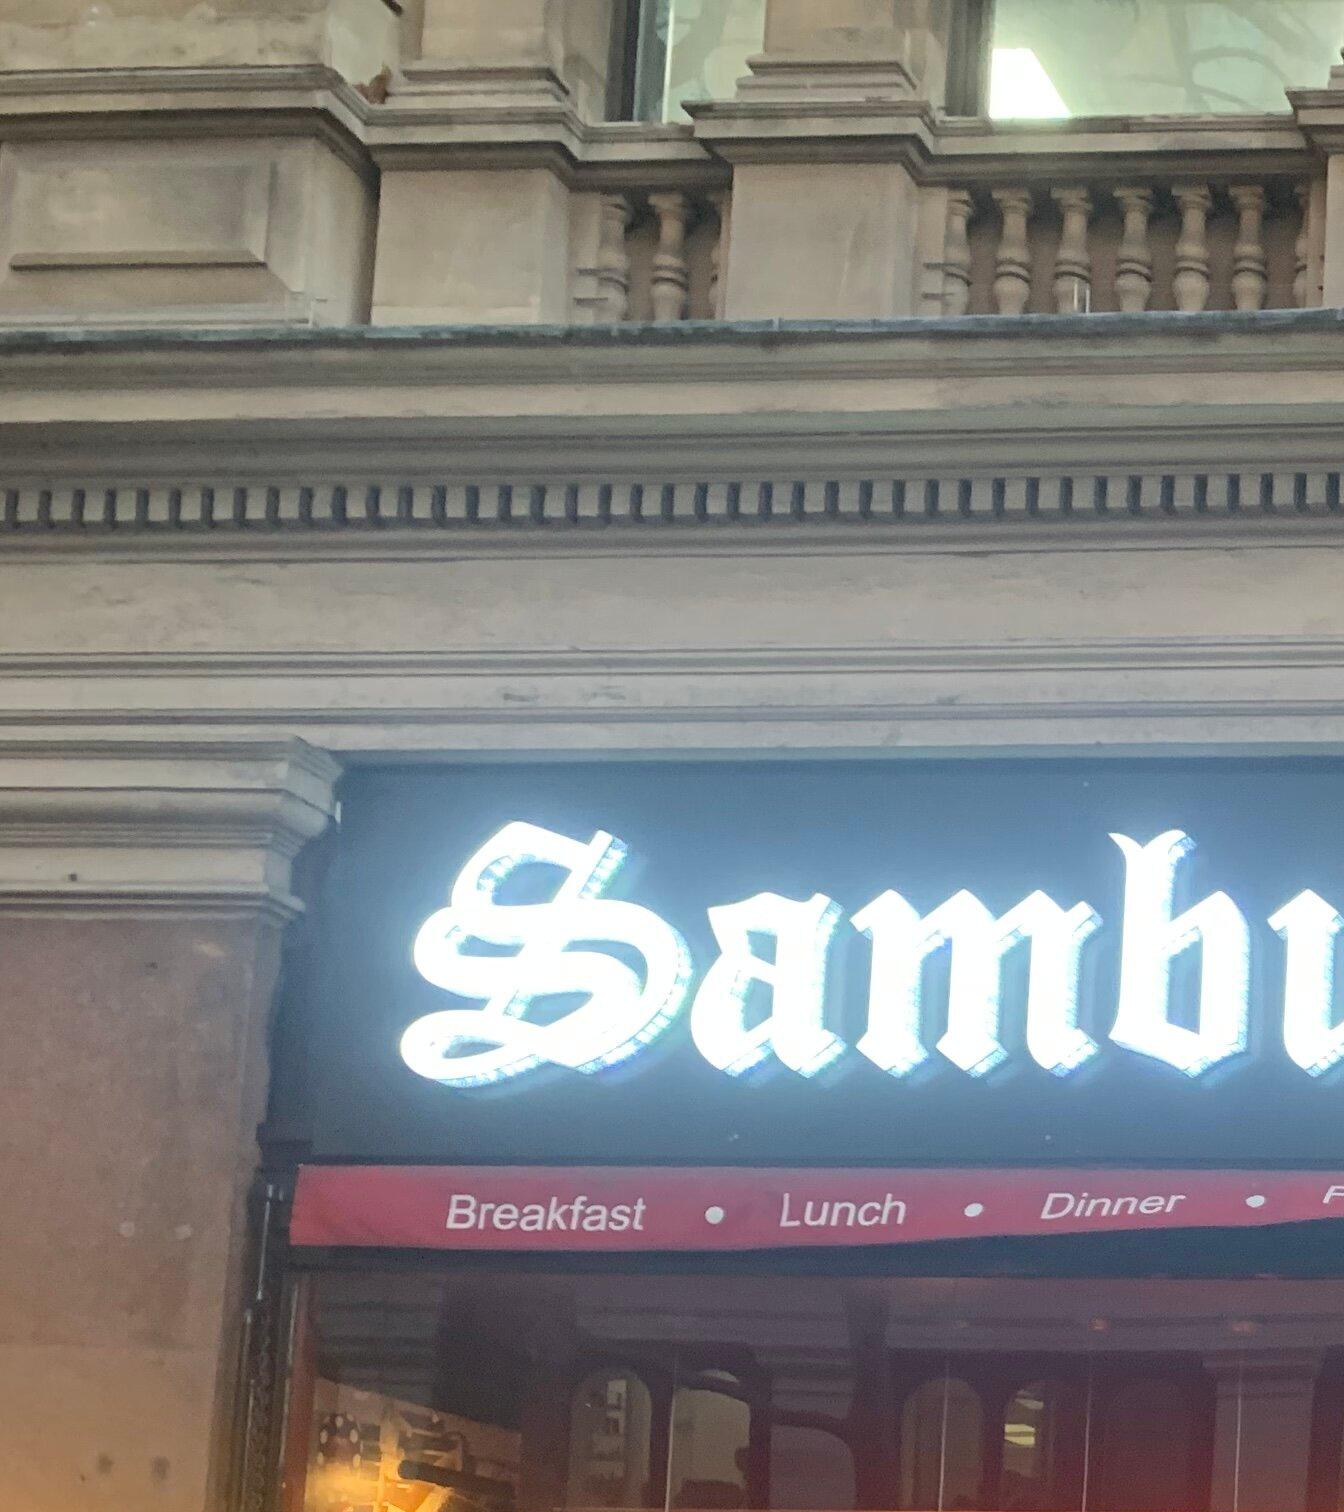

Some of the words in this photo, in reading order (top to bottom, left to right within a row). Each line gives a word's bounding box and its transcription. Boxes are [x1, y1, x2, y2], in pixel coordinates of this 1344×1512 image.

[446, 1194, 646, 1232] Breakfast
[780, 1192, 906, 1227] Lunch
[1040, 1191, 1186, 1221] Dinner
